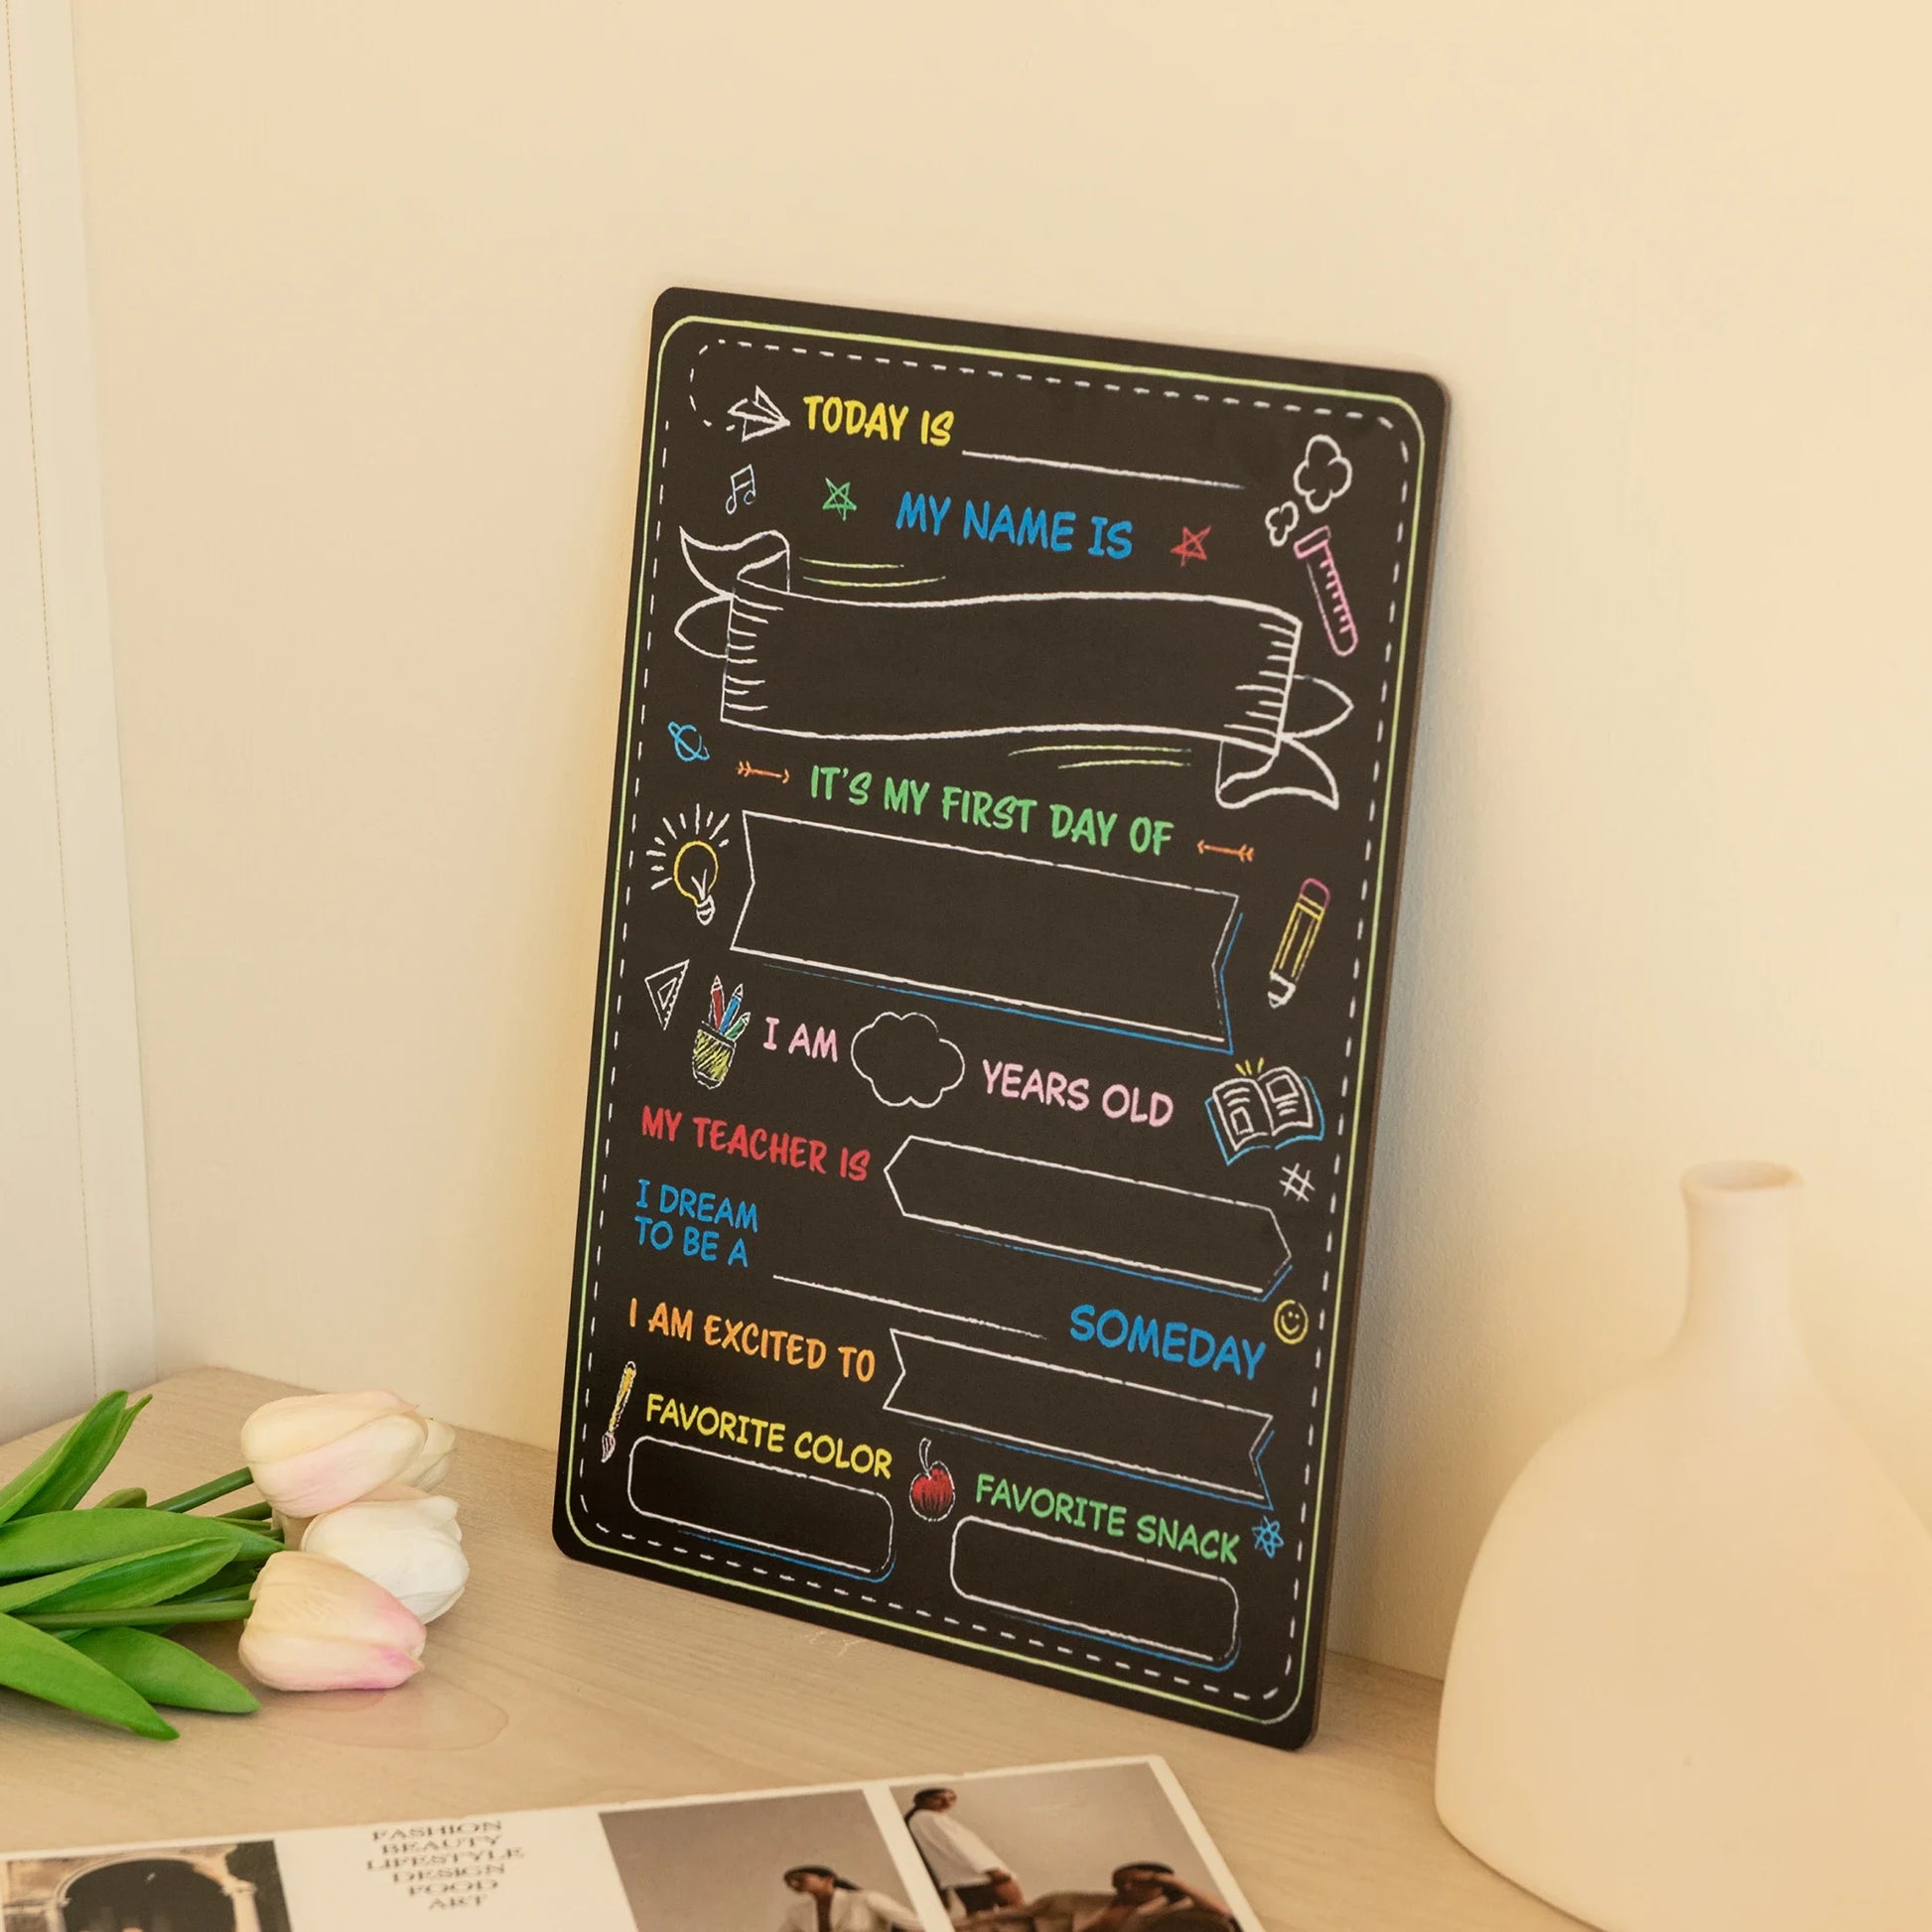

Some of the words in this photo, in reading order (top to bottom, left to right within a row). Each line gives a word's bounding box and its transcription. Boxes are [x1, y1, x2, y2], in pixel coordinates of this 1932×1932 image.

[802, 394, 909, 442] TODAY
[920, 409, 955, 448] IS
[895, 491, 950, 536] MY
[962, 499, 1077, 552] NAME
[1087, 515, 1133, 560] IS
[810, 764, 873, 806] IT'S
[884, 776, 930, 816] MY
[941, 785, 1038, 834] FIRST
[1048, 803, 1119, 848] DAY
[1129, 816, 1175, 857] OF
[762, 1016, 780, 1051] I
[787, 1023, 839, 1063] AM
[982, 1058, 1090, 1112] YEARS
[1101, 1083, 1174, 1128] OLD
[641, 1104, 683, 1143] MY
[692, 1116, 828, 1175] TEACHER
[839, 1147, 872, 1182] IS
[635, 1178, 651, 1208] I
[658, 1183, 759, 1230] DREAM
[633, 1215, 674, 1251] TO
[682, 1226, 720, 1262] BE
[727, 1238, 749, 1268] A
[628, 1297, 638, 1328] I
[647, 1302, 694, 1342] AM
[703, 1313, 827, 1370] EXCITED
[837, 1345, 876, 1383] TO
[1068, 1304, 1267, 1381] SOMEDAY
[645, 1393, 786, 1452] FAVORITE
[795, 1431, 893, 1479] COLOR
[975, 1473, 1127, 1537] FAVORITE
[1136, 1514, 1240, 1565] SNACK
[372, 1820, 502, 1842] FASHION
[382, 1836, 502, 1855] BEAUTY
[366, 1847, 524, 1870] LIFESTYLE
[393, 1863, 505, 1883] DESIGN
[409, 1879, 498, 1897] FOOD
[428, 1893, 484, 1911] ART
